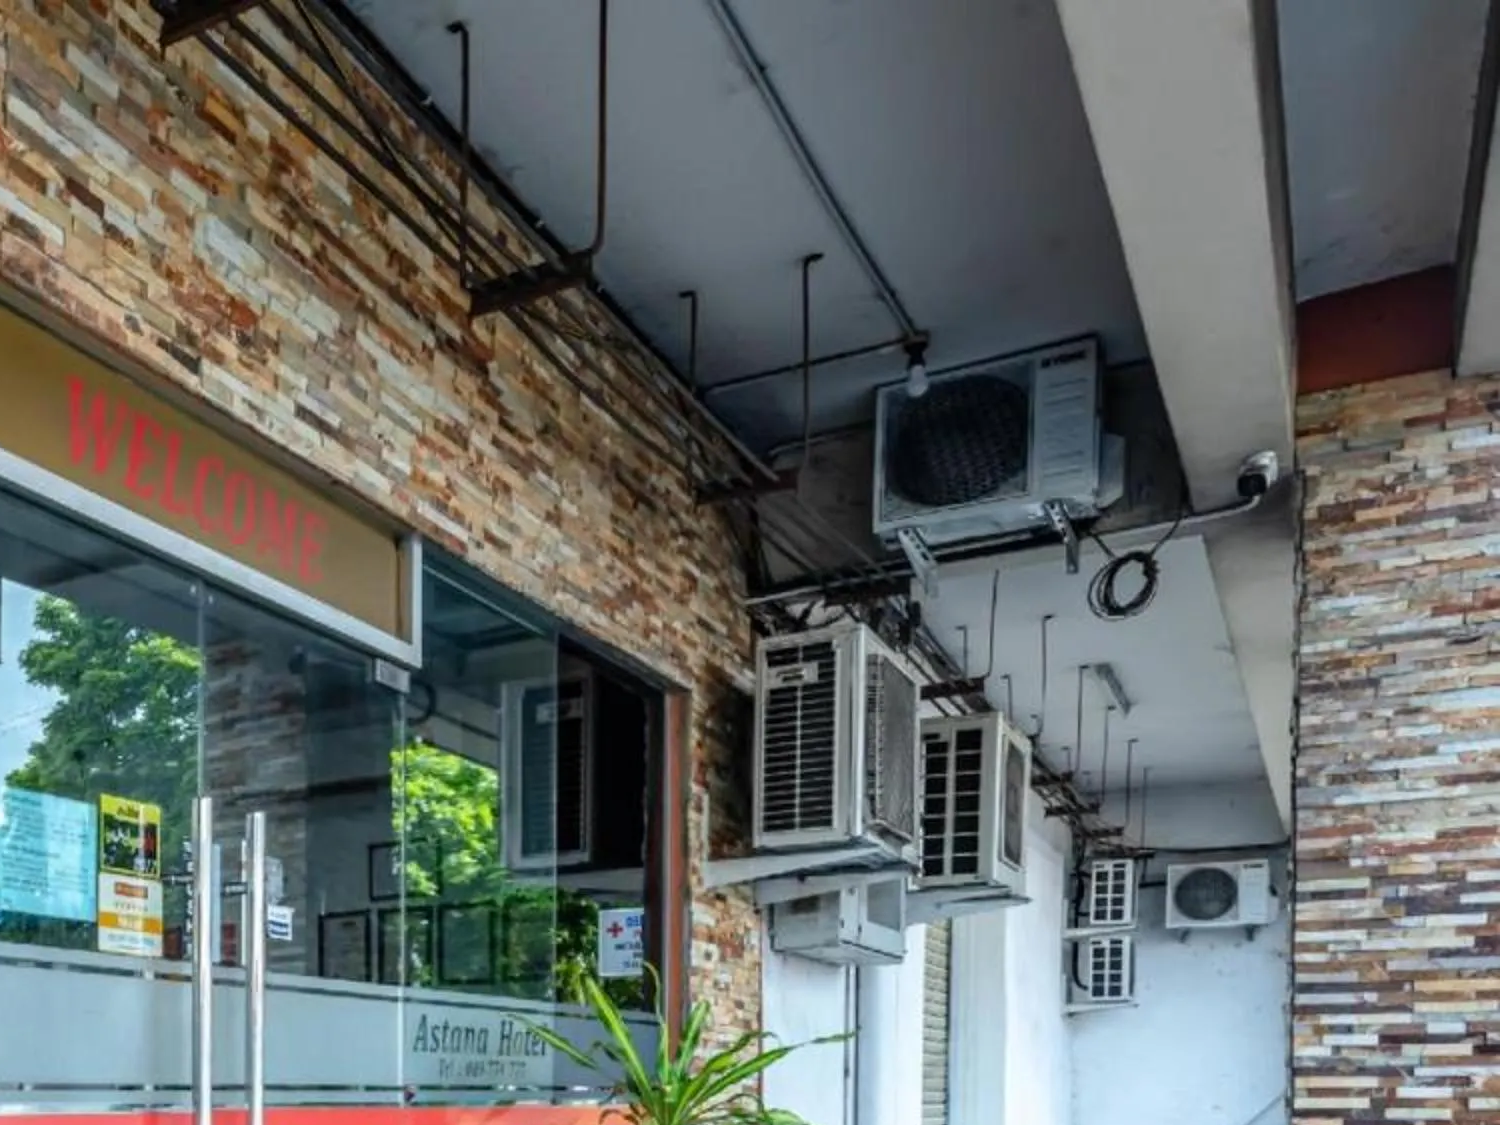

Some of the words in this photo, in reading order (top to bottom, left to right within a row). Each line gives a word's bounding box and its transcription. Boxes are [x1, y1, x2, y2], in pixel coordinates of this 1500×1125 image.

[66, 374, 329, 586] WELCOME
[412, 1013, 490, 1056] Astana
[498, 1018, 549, 1057] Hotel
